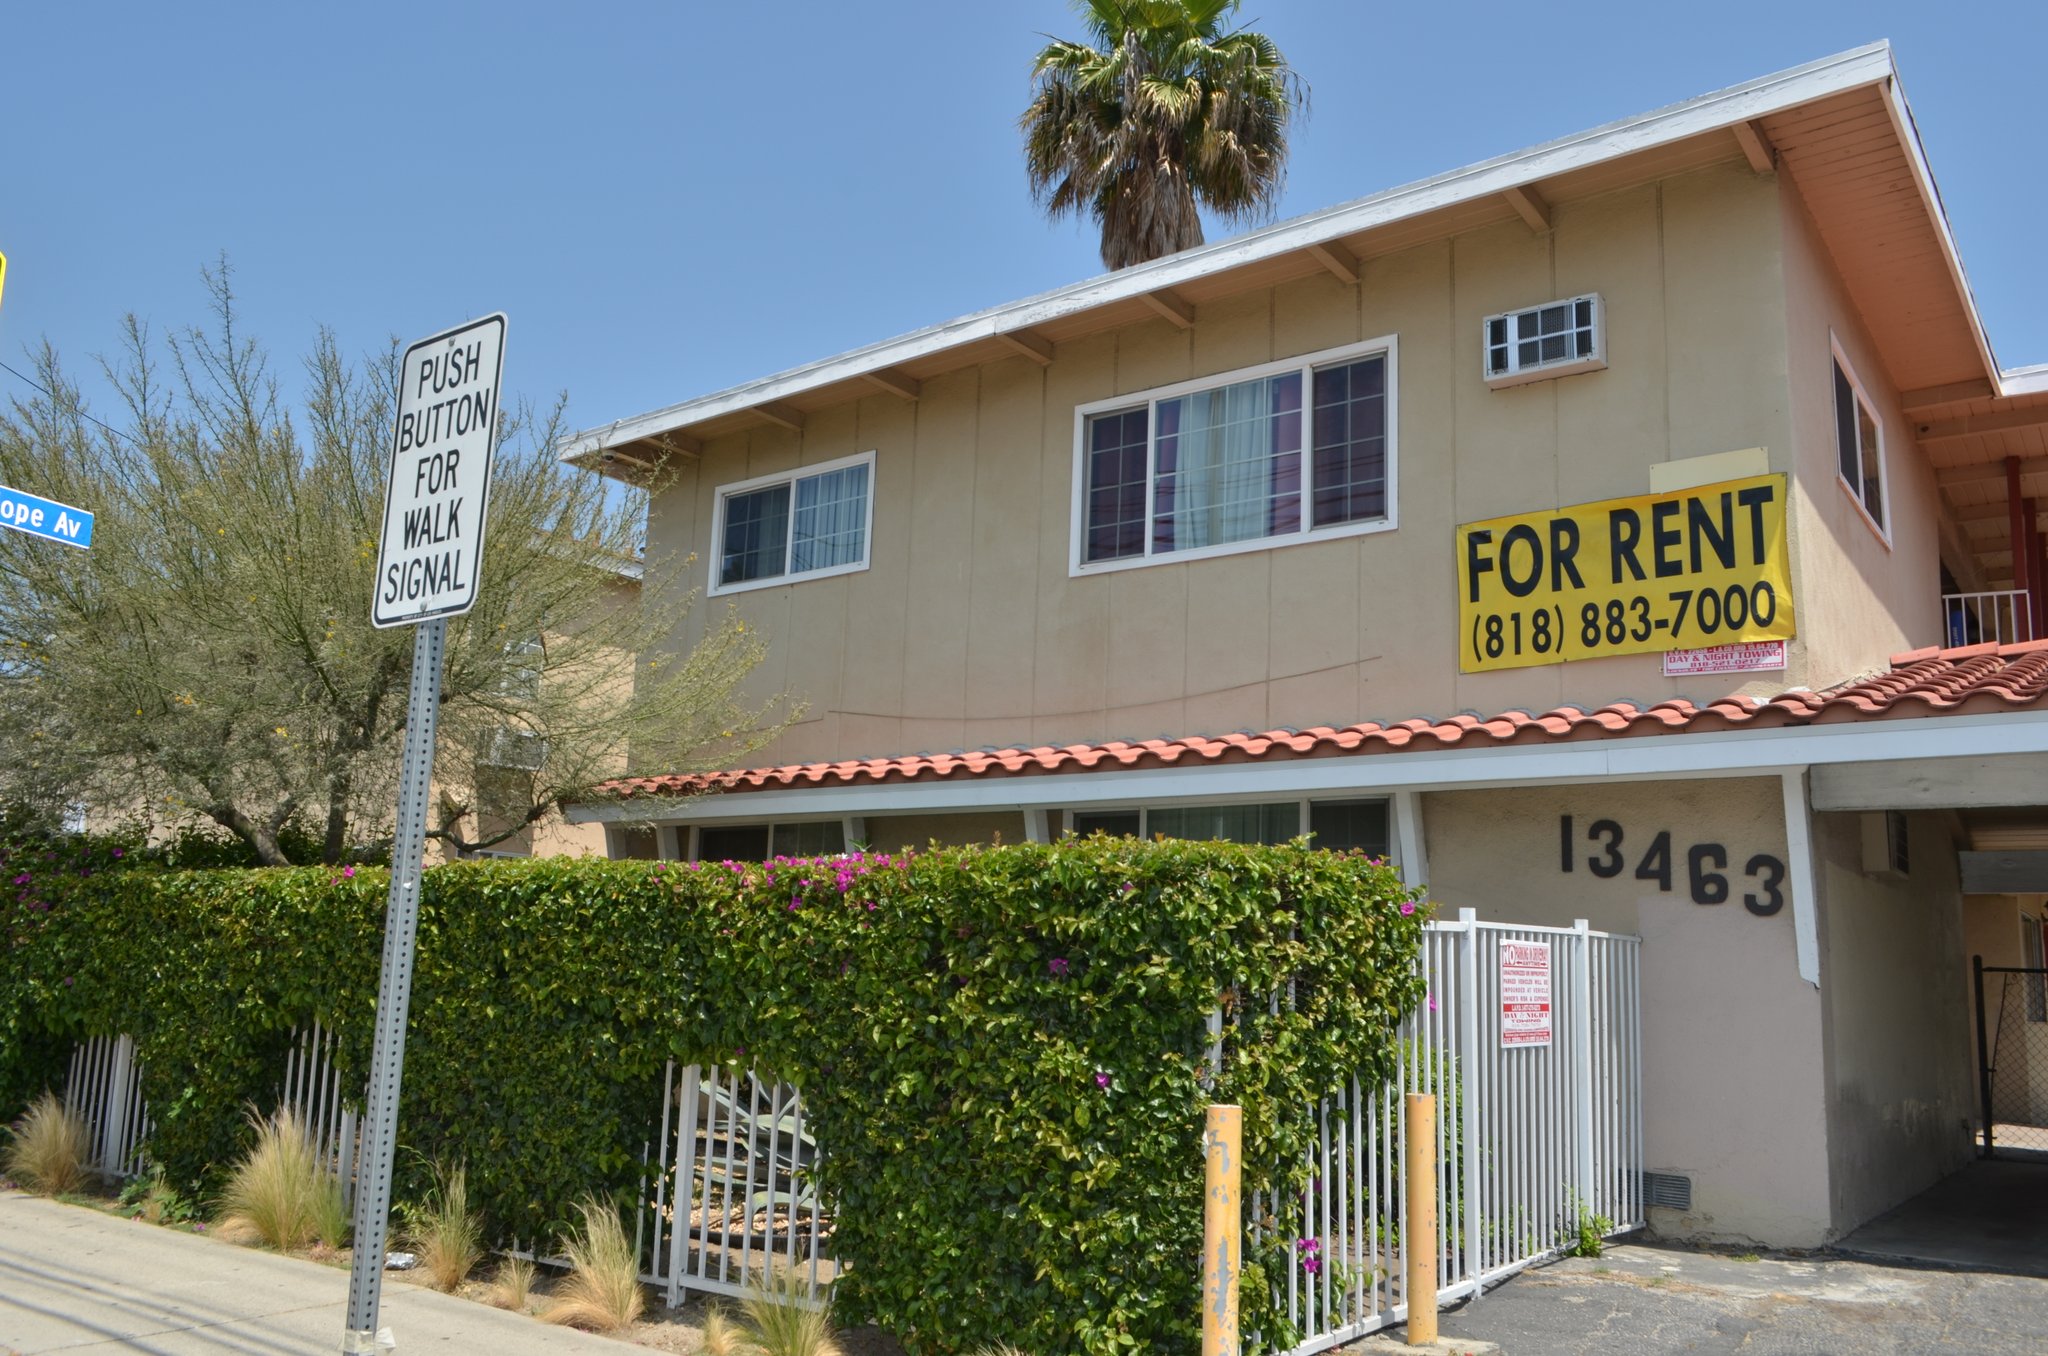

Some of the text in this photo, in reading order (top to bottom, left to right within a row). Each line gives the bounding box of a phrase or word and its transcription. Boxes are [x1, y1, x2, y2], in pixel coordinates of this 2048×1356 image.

[418, 341, 481, 399] PUSH
[400, 388, 490, 453] BUTTON
[414, 448, 460, 499] FOR
[53, 511, 81, 538] Av
[403, 497, 463, 551] WALK
[1467, 485, 1774, 603] FOR RENT
[384, 549, 465, 604] SIGNAL
[1472, 580, 1776, 663] (818) 883-7000
[1669, 655, 1689, 663] DAY
[1703, 652, 1734, 662] NIGHT
[1738, 649, 1780, 659] TOWING
[1560, 815, 1785, 917] 13463
[1503, 945, 1516, 966] NO
